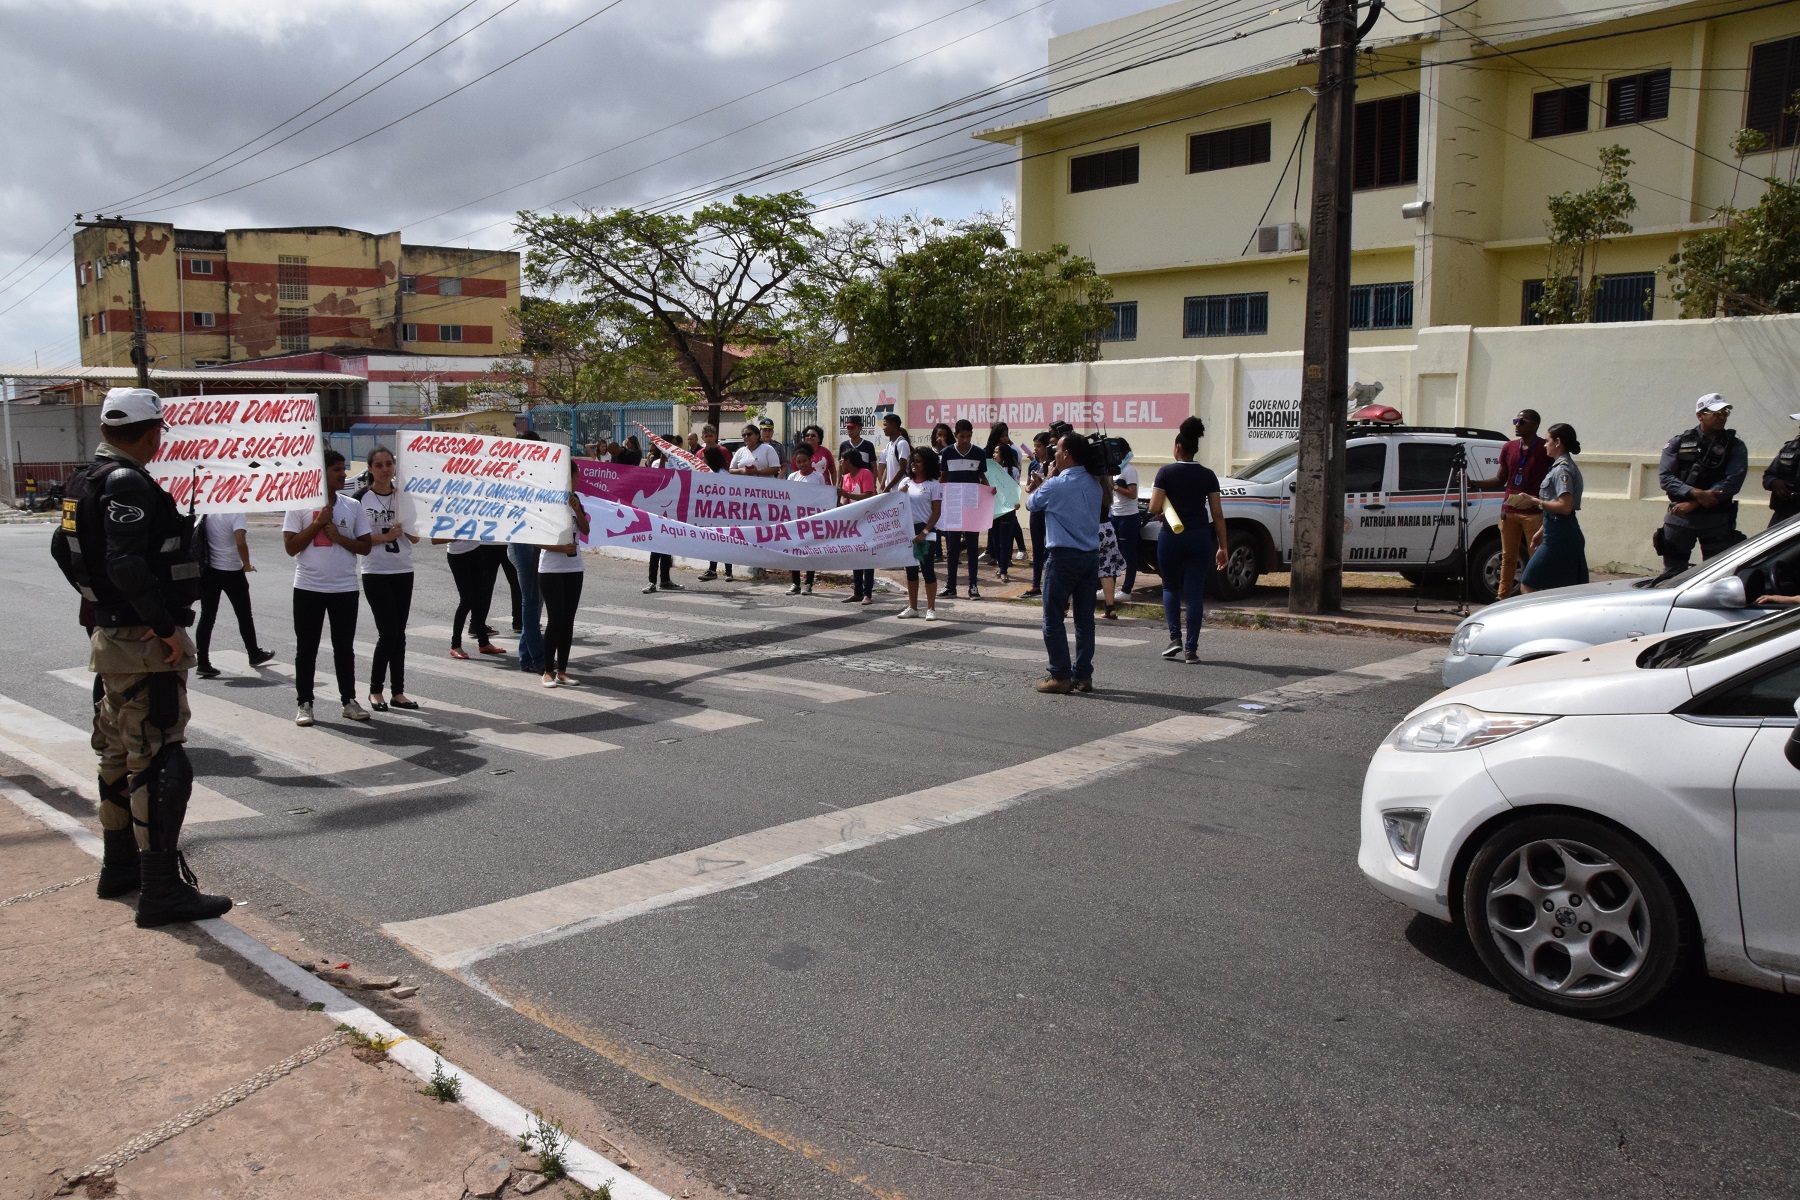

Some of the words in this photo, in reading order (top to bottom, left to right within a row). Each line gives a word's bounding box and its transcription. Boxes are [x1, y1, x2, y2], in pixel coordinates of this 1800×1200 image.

[840, 406, 863, 415] GOVERNO
[865, 406, 873, 414] DO
[1053, 401, 1104, 423] PIRES
[1112, 400, 1163, 423] LEAL
[1249, 399, 1290, 409] GOVERNO
[1248, 430, 1276, 439] GOVERNO
[1276, 430, 1284, 439] DE
[164, 437, 220, 463] MURO
[217, 436, 244, 460] DE
[242, 431, 315, 460] SILÊNCIO
[489, 440, 550, 463] CONTRA
[552, 448, 562, 464] A
[442, 456, 525, 479] MULHER:
[583, 467, 620, 480] carinho.
[167, 470, 213, 506] VOCÊ
[207, 473, 259, 504] PODE
[255, 468, 323, 503] DERRUBAR.
[404, 476, 441, 494] DIGA
[441, 477, 472, 496] NÃO
[697, 483, 725, 497] AÇÃO
[729, 486, 742, 497] DA
[745, 487, 791, 500] PATRULHA
[431, 496, 444, 513] A
[445, 497, 506, 520] CULTURA
[507, 506, 527, 522] DA
[694, 499, 762, 521] MARIA
[768, 503, 792, 522] DA
[872, 521, 891, 534] LIGUE
[1360, 516, 1396, 527] PATRULHA
[1397, 515, 1420, 527] MARIA
[1422, 515, 1431, 527] DA
[631, 534, 646, 543] ANO
[648, 533, 653, 541] 6
[661, 523, 687, 538] Aqui
[690, 530, 697, 539] a
[792, 545, 821, 556] mulher
[823, 544, 838, 554] não
[839, 544, 854, 553] tem
[855, 541, 869, 553] vez!
[755, 523, 792, 544] DA
[796, 519, 863, 540] PENHA
[1349, 547, 1408, 560] MILITAR
